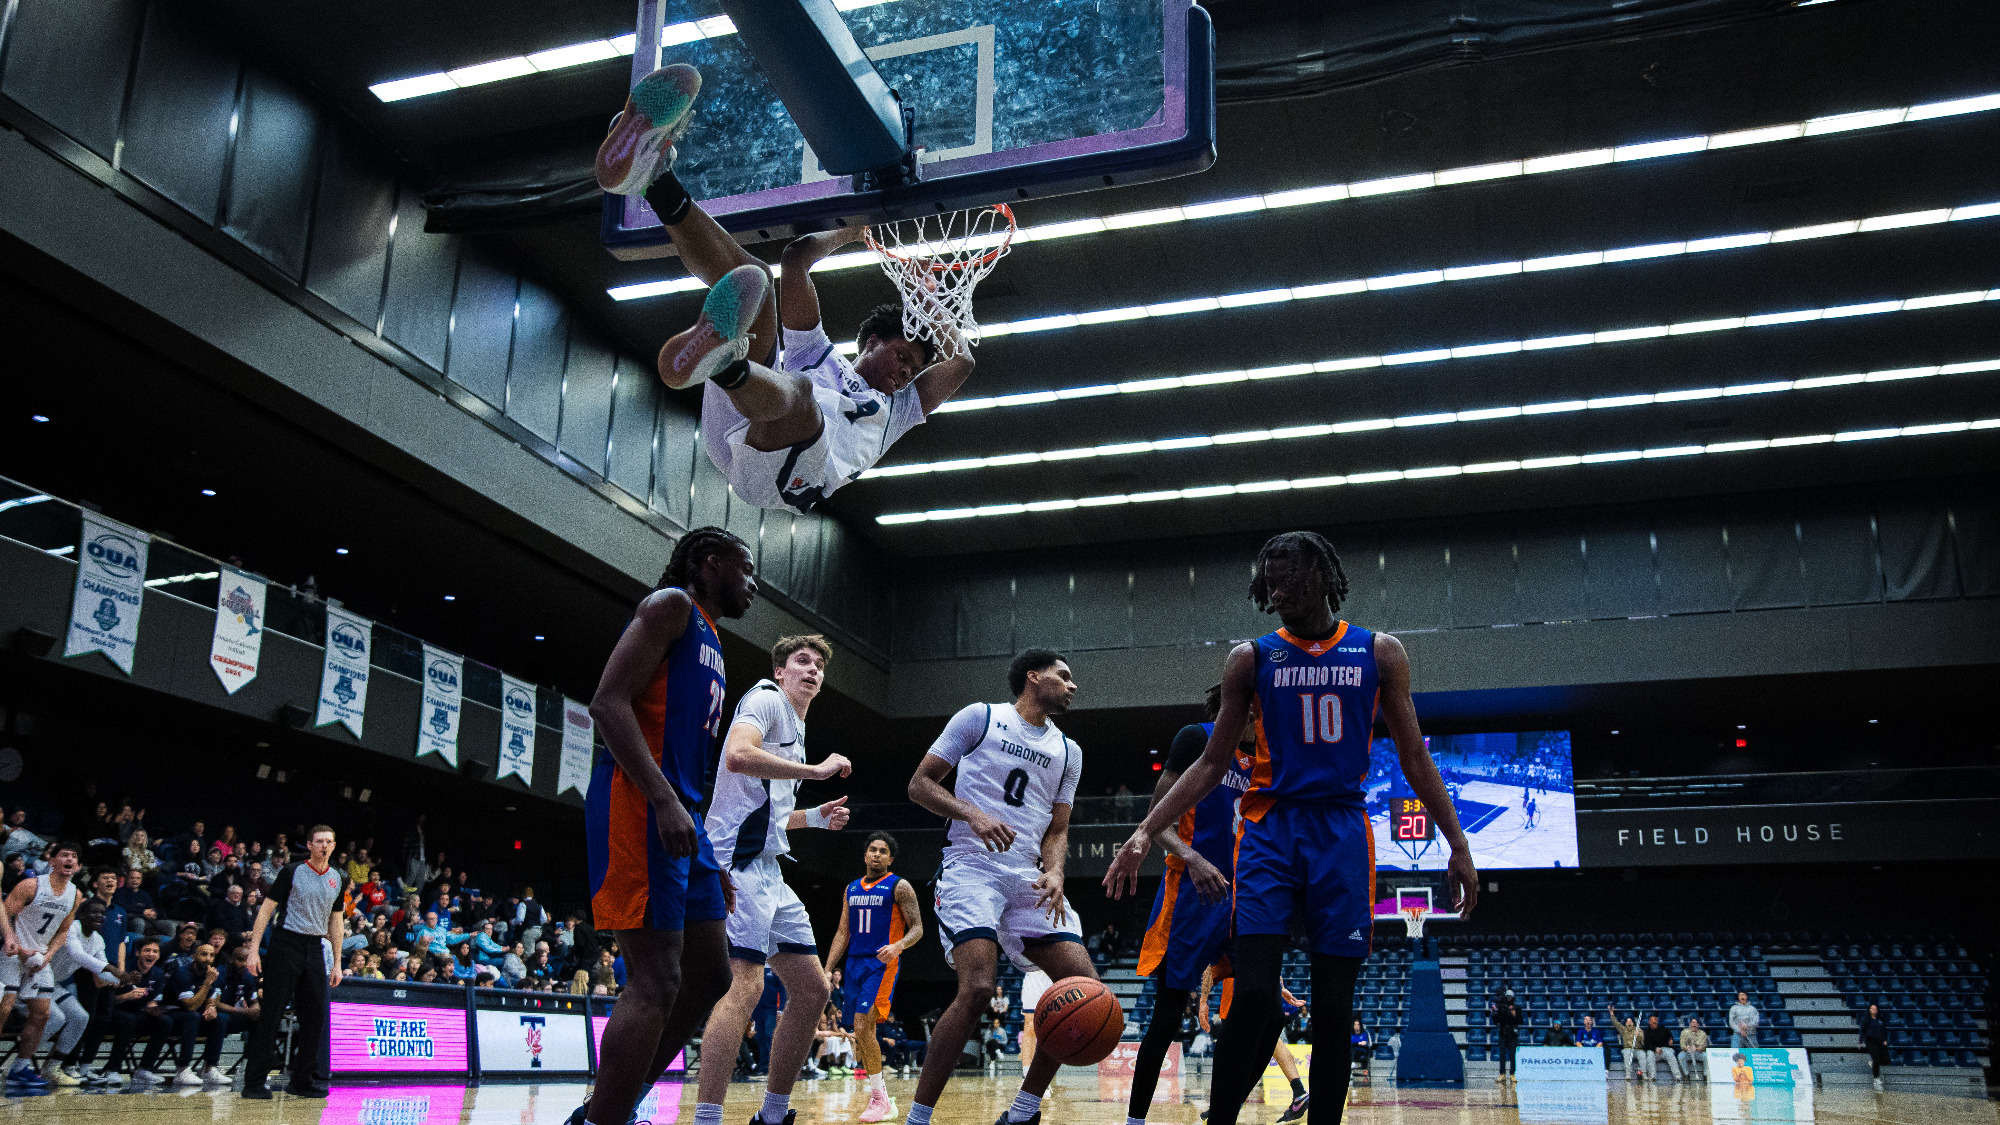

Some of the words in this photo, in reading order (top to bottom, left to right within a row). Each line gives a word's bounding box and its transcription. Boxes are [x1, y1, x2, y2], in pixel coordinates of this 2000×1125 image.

[87, 541, 140, 573] OUA
[83, 578, 140, 606] CHAMPIONS
[331, 629, 366, 654] OUA
[1337, 646, 1368, 654] OUA
[328, 661, 367, 682] CHAMPIONS
[427, 666, 458, 687] OUA
[1274, 666, 1329, 688] ONTARIO
[1331, 666, 1362, 687] TECH
[426, 695, 459, 713] CHAMPIONS
[505, 695, 533, 713] OUA
[504, 721, 534, 738] CHAMPIONS
[1297, 693, 1344, 744] 10
[1001, 739, 1052, 769] TORONTO
[1004, 768, 1029, 807] 0
[1398, 815, 1426, 838] 20
[1617, 827, 1709, 845] FIELD
[1736, 823, 1843, 843] HOUSE
[849, 895, 870, 906] ONTARIO
[870, 895, 884, 906] TECH
[37, 912, 56, 934] 7
[858, 909, 871, 933] 11
[1036, 988, 1087, 1028] Wilson
[374, 1018, 398, 1037] WE
[400, 1020, 427, 1038] ARE
[367, 1037, 433, 1058] TORONTO
